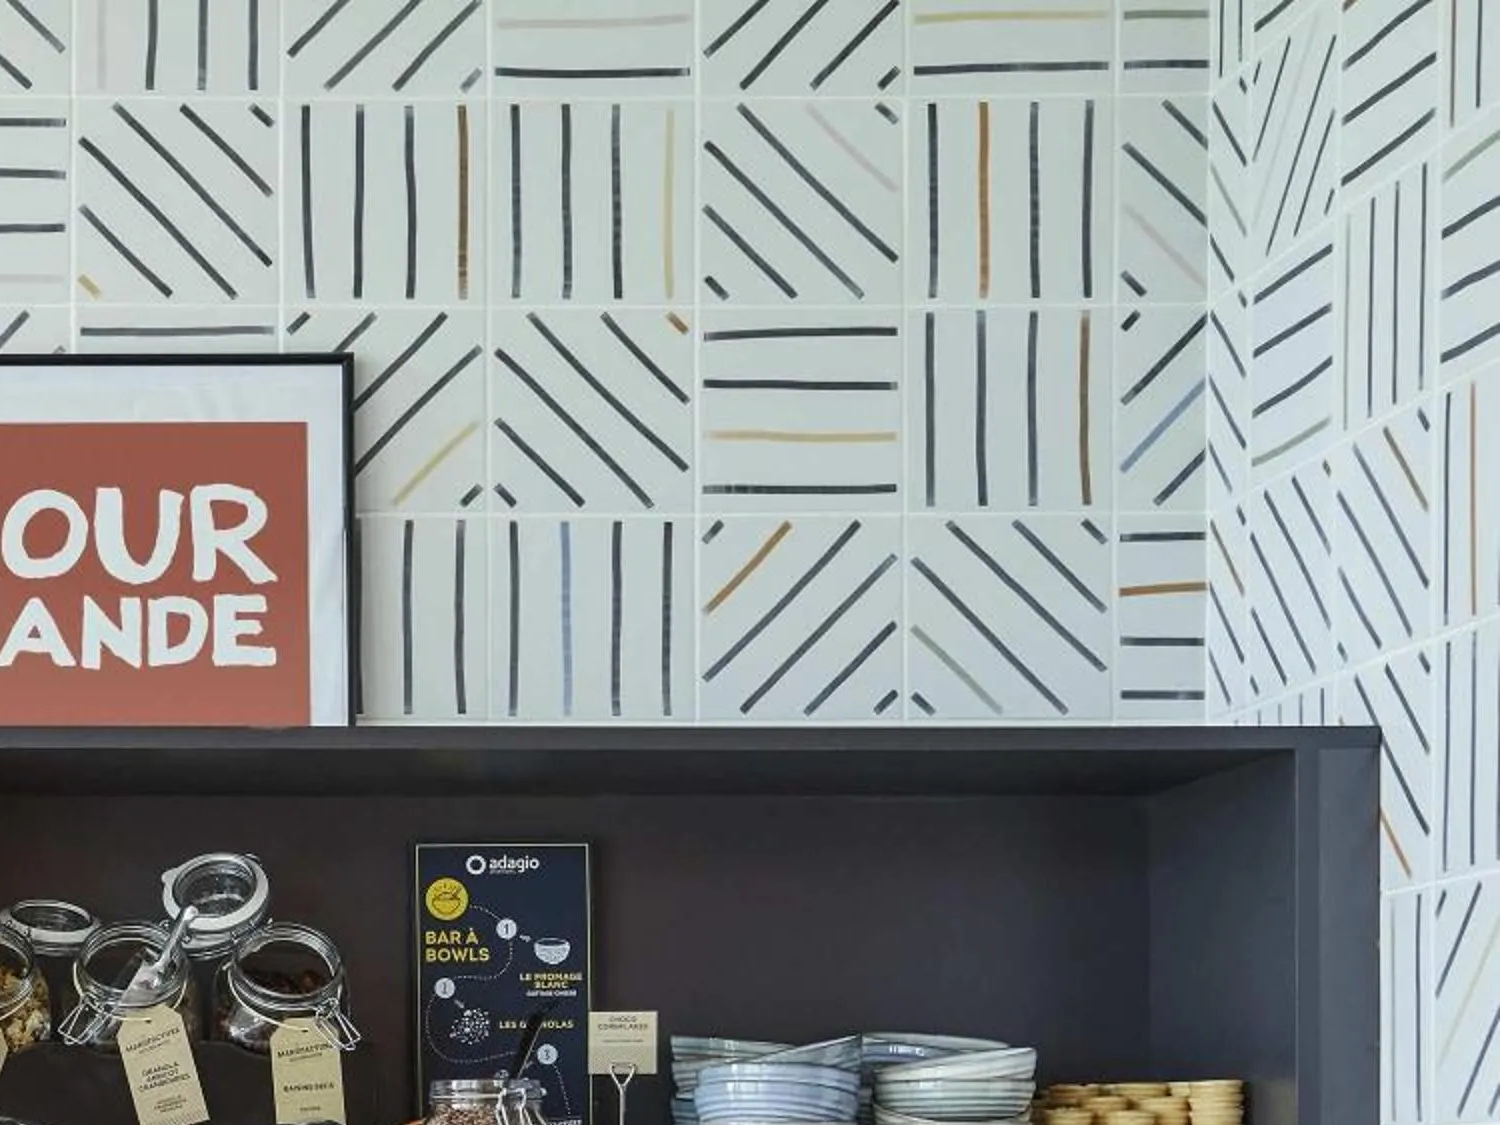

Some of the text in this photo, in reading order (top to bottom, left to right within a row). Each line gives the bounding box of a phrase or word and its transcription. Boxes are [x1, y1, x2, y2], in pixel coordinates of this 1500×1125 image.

[488, 854, 540, 872] adagio
[425, 931, 464, 944] BAR
[425, 948, 490, 962] BOWLS
